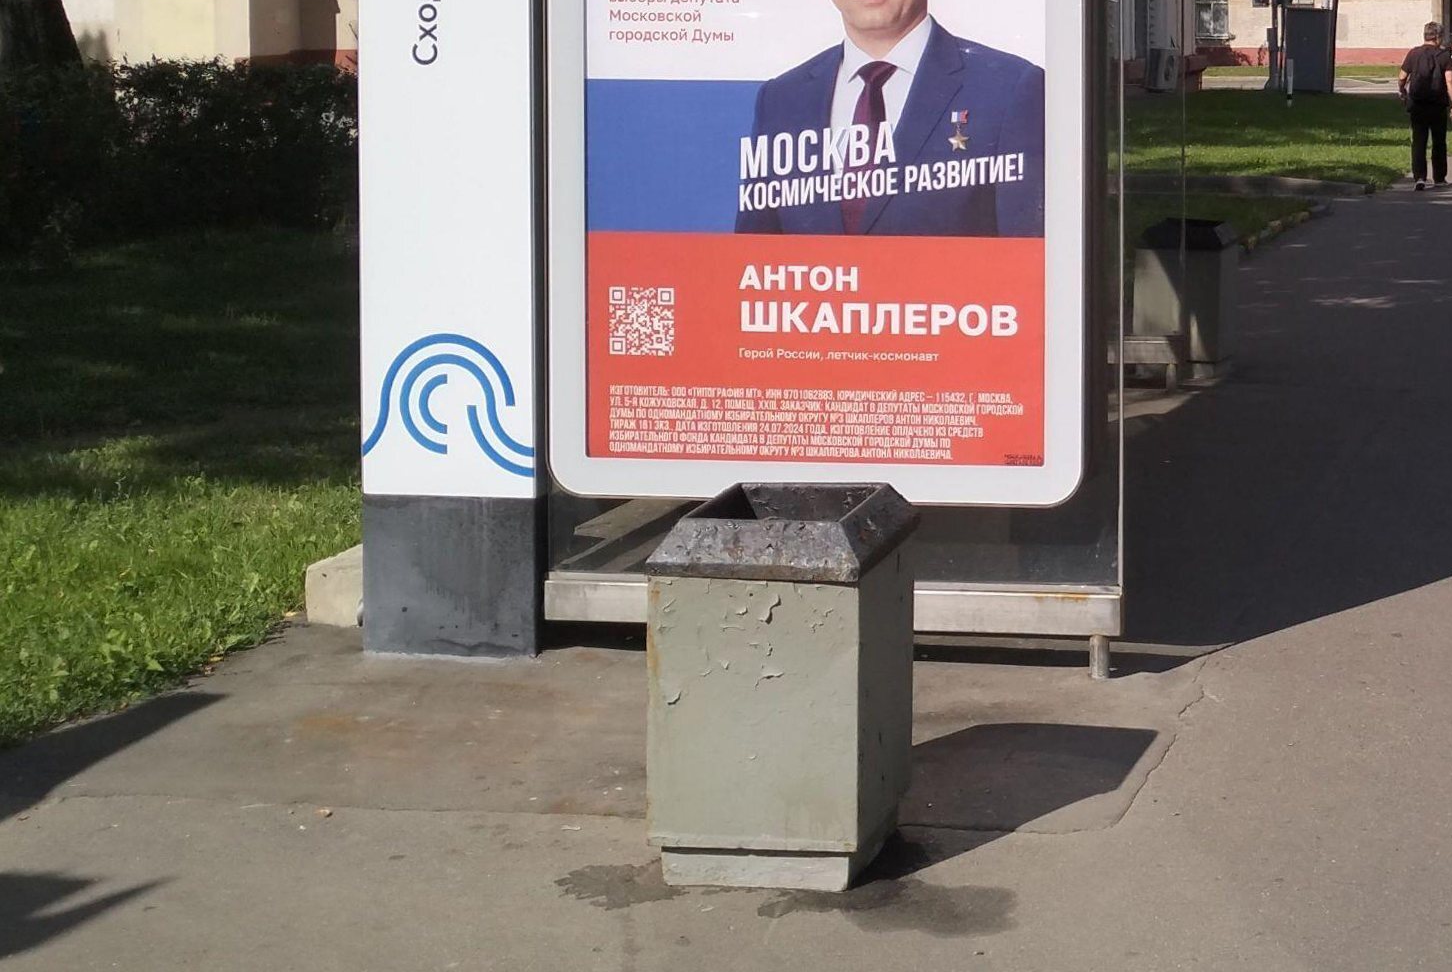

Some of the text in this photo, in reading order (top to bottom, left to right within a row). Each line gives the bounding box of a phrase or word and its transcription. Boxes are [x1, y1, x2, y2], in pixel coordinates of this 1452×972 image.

[608, 9, 702, 23] Московской
[608, 28, 735, 45] городской Думы
[739, 120, 897, 179] МОСКВА
[738, 152, 1025, 212] КОСМИЧЕСКОЕ РАЗВИТИЕ!
[739, 264, 859, 292] АНТОН
[740, 300, 1019, 338] ШКАПЛЕРОВ
[738, 346, 940, 363] Герой России, летчик-космонавт
[671, 386, 686, 397] ООО
[836, 389, 898, 402] ЮРИДИЧЕСКИЙ
[900, 391, 925, 403] АДРЕС
[609, 408, 634, 419] ДУМЫ
[635, 408, 646, 419] ПО
[798, 412, 828, 423] ОКРУГУ
[845, 413, 895, 425] ШКАПЛЕРОВ
[896, 414, 922, 425] АНТОН
[824, 401, 868, 412] КАНДИДАТ
[877, 402, 920, 414] ДЕПУТАТЫ
[921, 402, 975, 415] МОСКОВСКОЙ
[976, 403, 1024, 416] ГОРОДСКОЙ
[610, 419, 636, 430] ТИРАЖ
[675, 421, 697, 432] ДАТА
[891, 426, 934, 437] ОПЛАЧЕНО
[936, 426, 947, 437] ИЗ
[948, 427, 984, 439] СРЕДСТВ
[679, 432, 709, 444] ФОНДА
[709, 433, 758, 445] КАНДИДАТА
[767, 434, 809, 446] ДЕПУТАТЫ
[810, 434, 862, 446] МОСКОВСКОЙ
[864, 435, 911, 448] ГОРОДСКОЙ
[912, 437, 938, 448] ДУМЫ
[940, 438, 951, 448] ПО
[760, 446, 790, 456] ОКРУГУ
